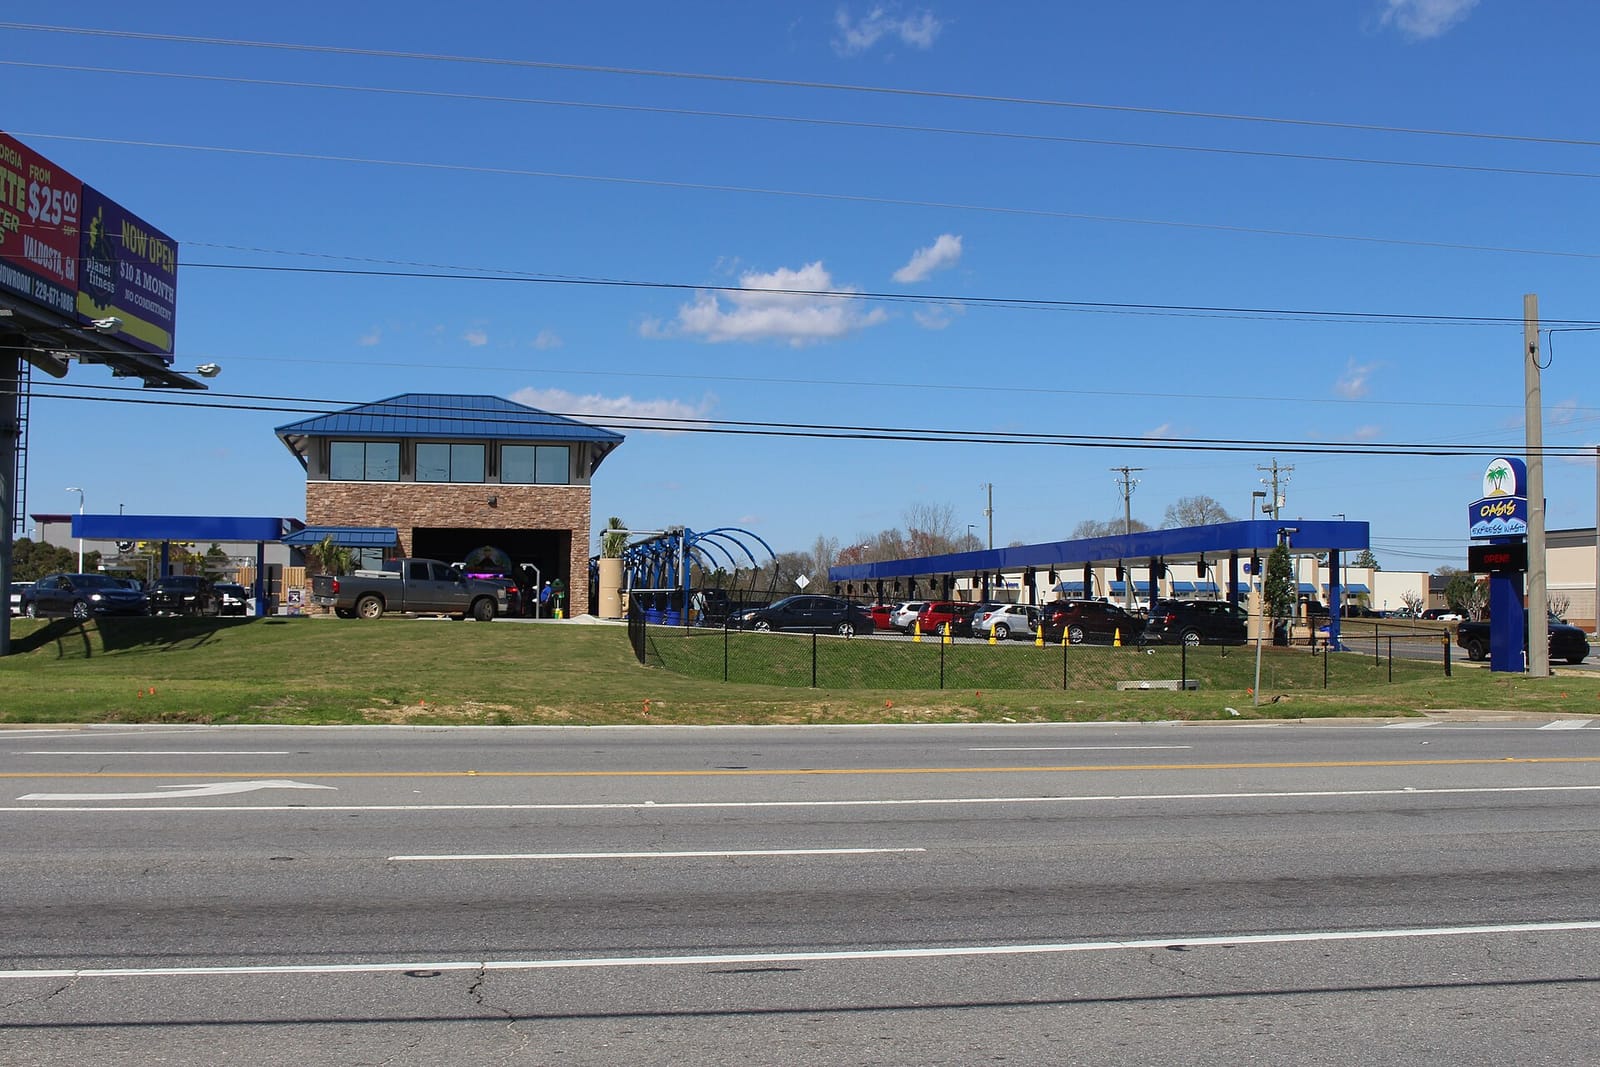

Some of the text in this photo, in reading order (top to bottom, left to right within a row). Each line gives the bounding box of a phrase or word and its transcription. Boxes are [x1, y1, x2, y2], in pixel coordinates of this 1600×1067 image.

[29, 164, 51, 184] FROM
[24, 234, 75, 281] VALDOSTA, GA
[121, 219, 174, 275] NOW OPEN
[86, 256, 111, 277] planet
[89, 270, 115, 293] fitness
[120, 260, 174, 304] $10 A MONTH
[124, 288, 172, 320] NO COMMITMENT
[1480, 500, 1517, 517] OASIS
[1471, 522, 1526, 535] EXPRESS WASH
